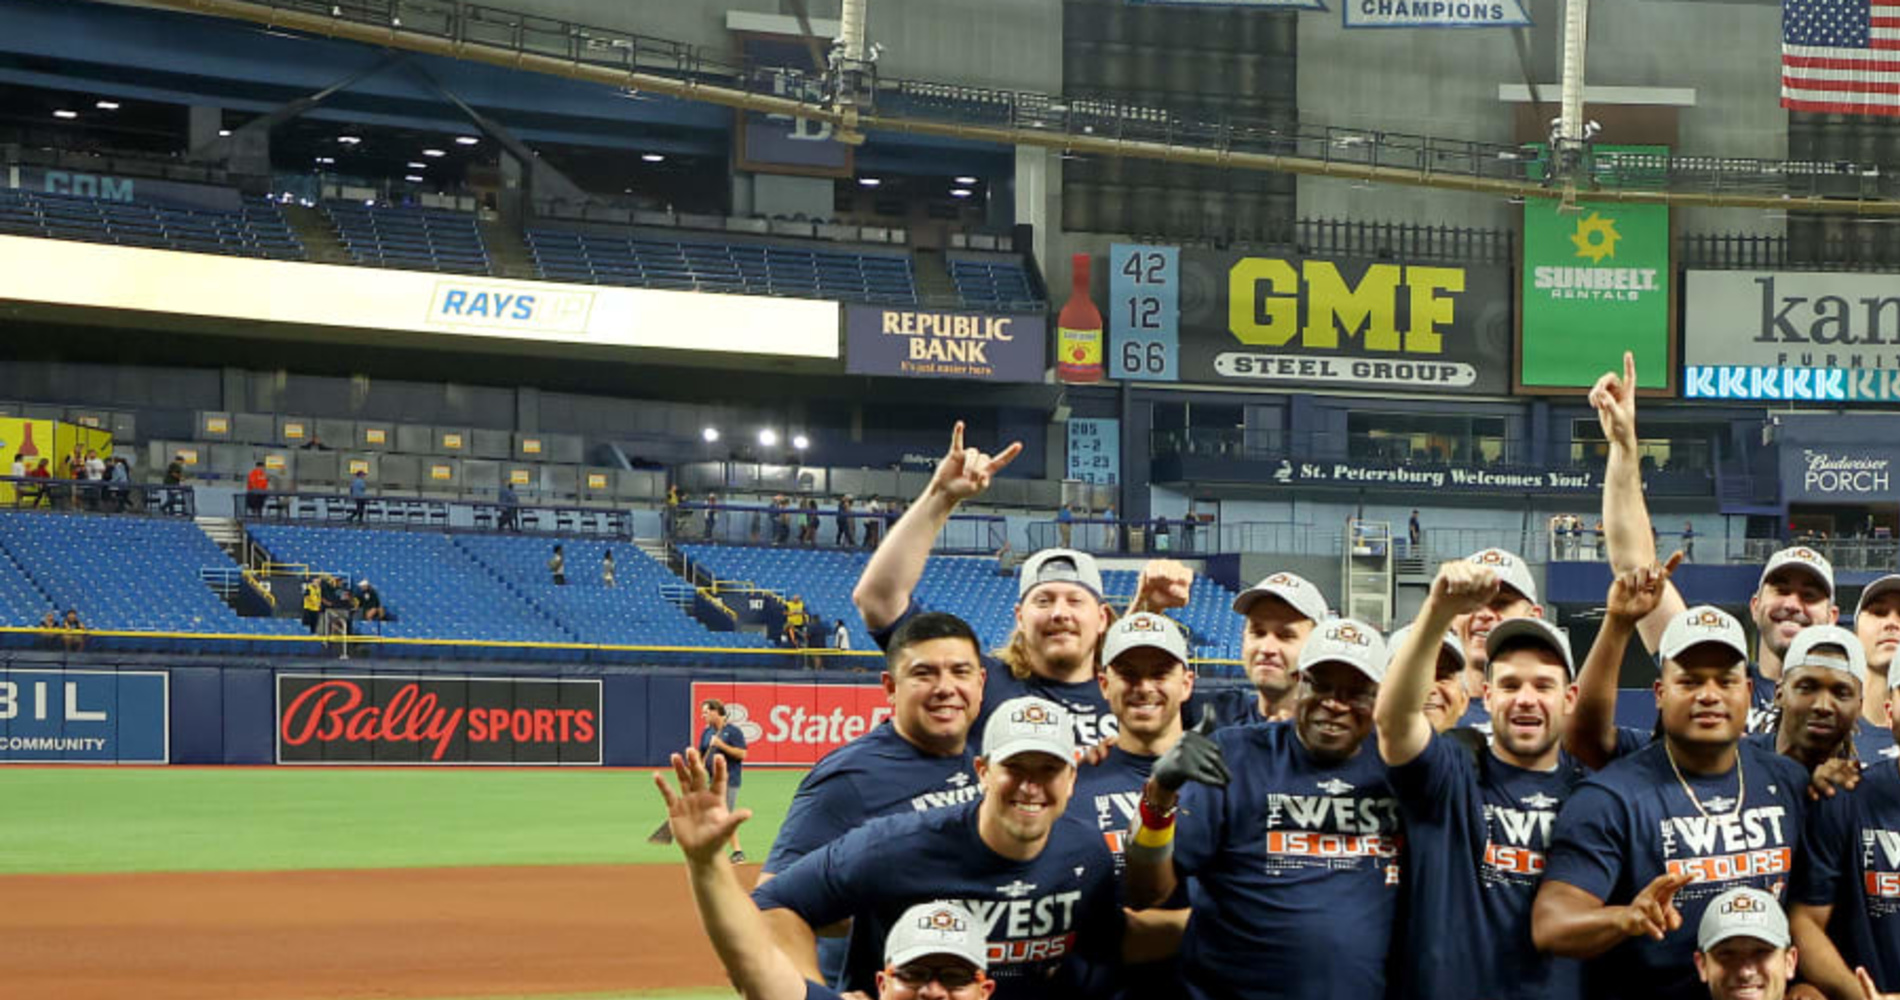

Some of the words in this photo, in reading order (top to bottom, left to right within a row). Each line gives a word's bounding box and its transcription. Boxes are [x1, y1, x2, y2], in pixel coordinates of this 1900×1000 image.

[1361, 0, 1505, 19] CHAMPIONS
[1123, 253, 1166, 284] 42
[1534, 266, 1657, 290] SUNBELT
[442, 289, 536, 320] RAYS
[1229, 257, 1465, 353] GMF
[1551, 289, 1640, 301] RENTALS
[882, 311, 1014, 341] REPUBLIC
[1128, 297, 1160, 328] 12
[909, 337, 988, 364] BANK
[1123, 341, 1165, 373] 66
[1234, 356, 1338, 377] STEEL
[1351, 362, 1459, 382] GROUP
[1300, 463, 1327, 479] St.
[1333, 465, 1445, 488] Petersburg
[1450, 468, 1543, 488] Welcomes
[1547, 471, 1591, 488] You!
[1804, 471, 1889, 491] PORCH
[281, 679, 467, 761] Bally
[468, 706, 595, 744] SPORTS
[766, 704, 865, 744] State
[0, 737, 106, 751] COMMUNITY
[1281, 833, 1311, 855] IS
[1672, 806, 1786, 855] WEST
[1715, 849, 1784, 877] OURS
